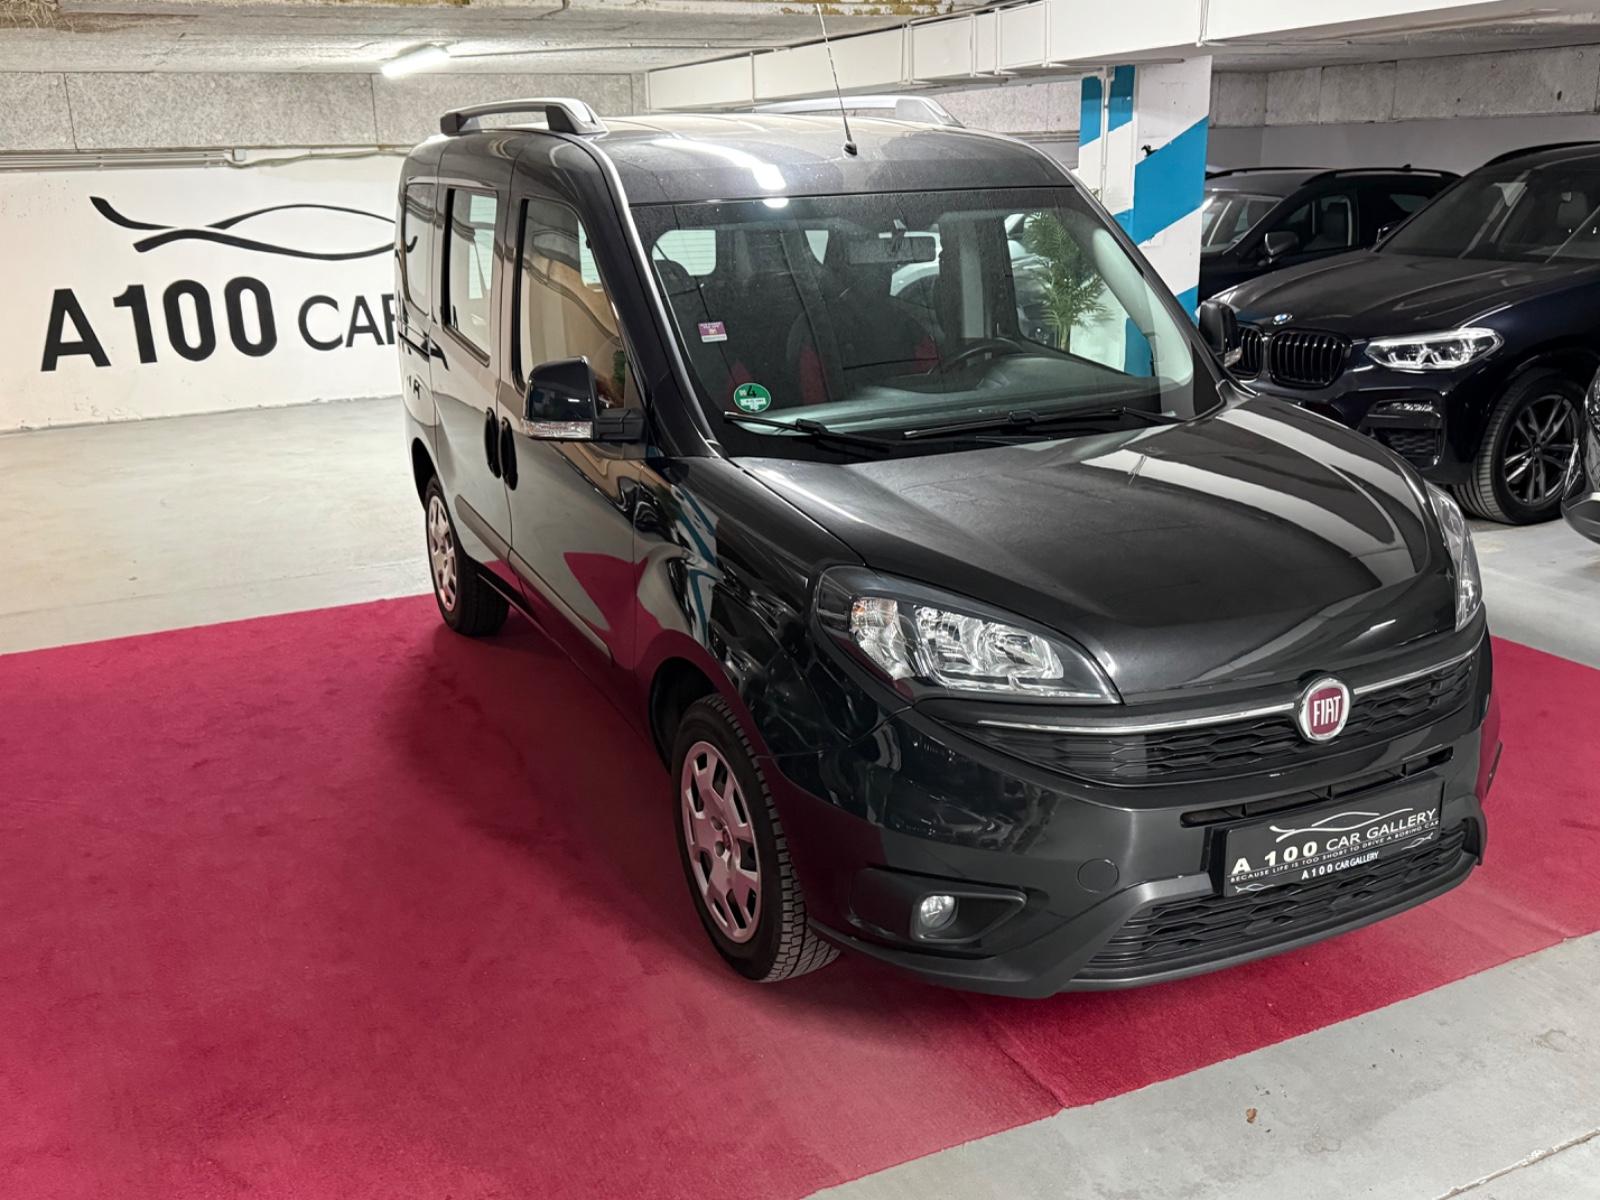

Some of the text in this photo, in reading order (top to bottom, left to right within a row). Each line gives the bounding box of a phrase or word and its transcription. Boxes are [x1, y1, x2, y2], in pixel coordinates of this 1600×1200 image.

[746, 385, 757, 398] 4
[1312, 695, 1342, 727] FIAT
[1326, 832, 1361, 851] CAR
[1366, 807, 1436, 839] GALLERY
[1230, 869, 1270, 883] BECAUSE
[1272, 864, 1289, 874] LIFE
[1302, 857, 1320, 866] TOO
[1322, 849, 1347, 860] SHORT
[1350, 845, 1360, 853] TO
[1362, 838, 1385, 849] DRIVE
[1395, 826, 1423, 839] BORING
[1424, 820, 1440, 829] CAR
